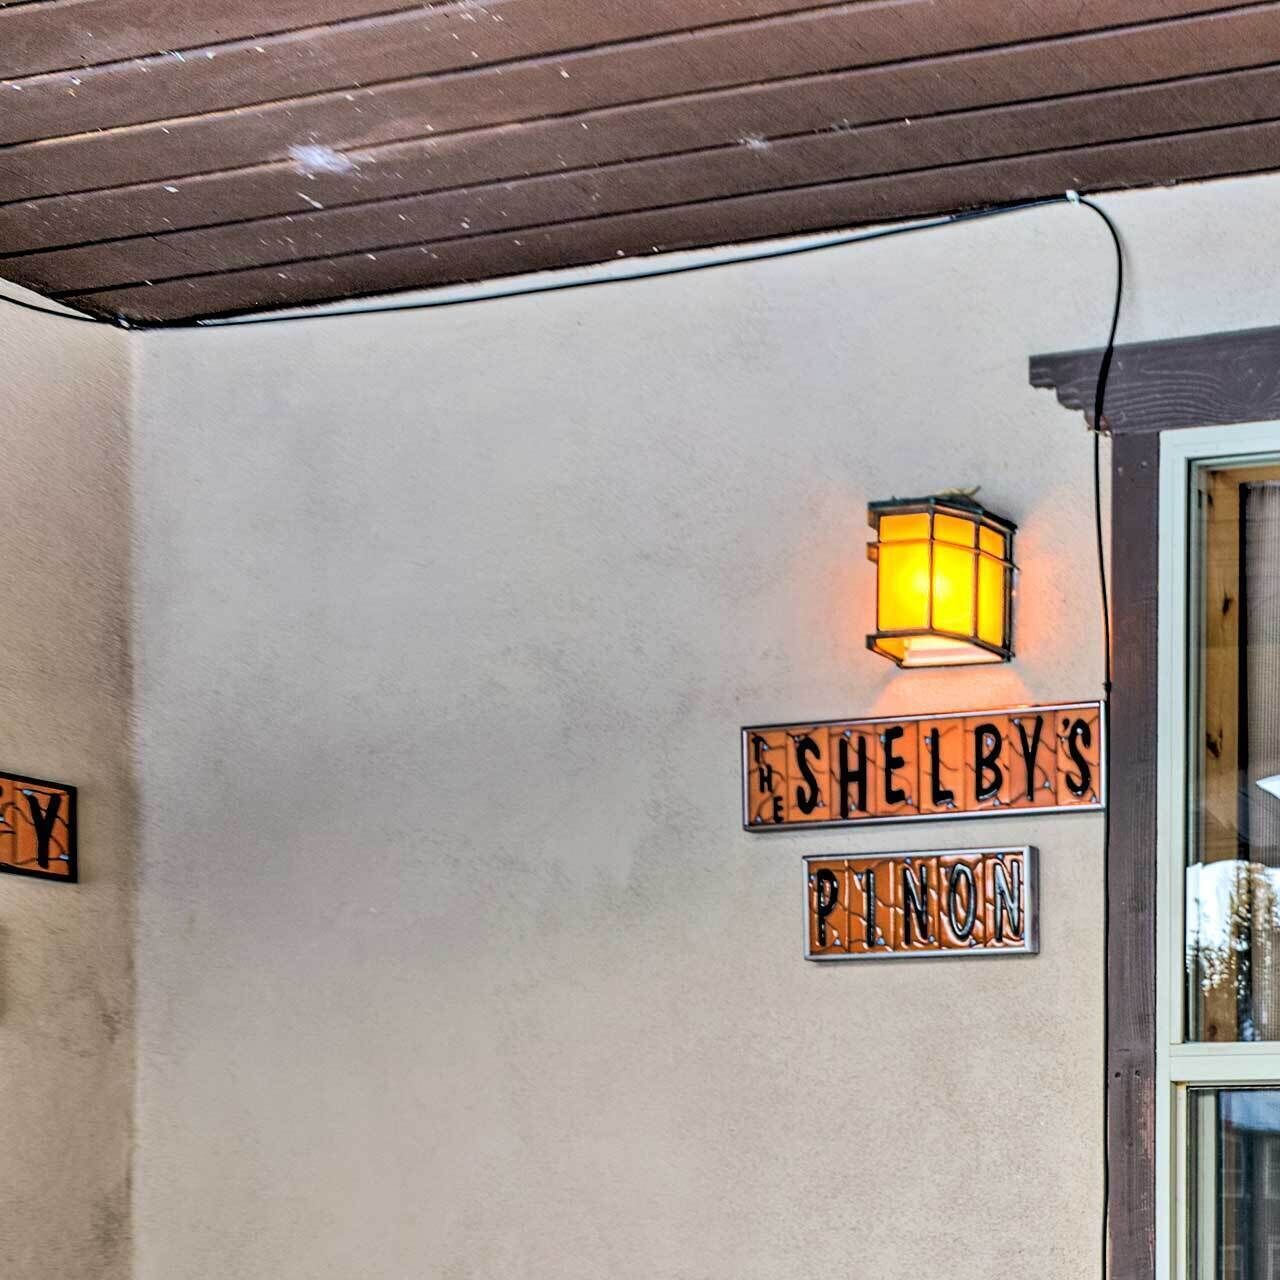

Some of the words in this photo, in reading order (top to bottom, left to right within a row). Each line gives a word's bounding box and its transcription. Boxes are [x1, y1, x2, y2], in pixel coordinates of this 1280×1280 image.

[751, 736, 784, 823] THE
[796, 716, 1092, 819] SHELBY'S
[816, 861, 1021, 947] PINON
